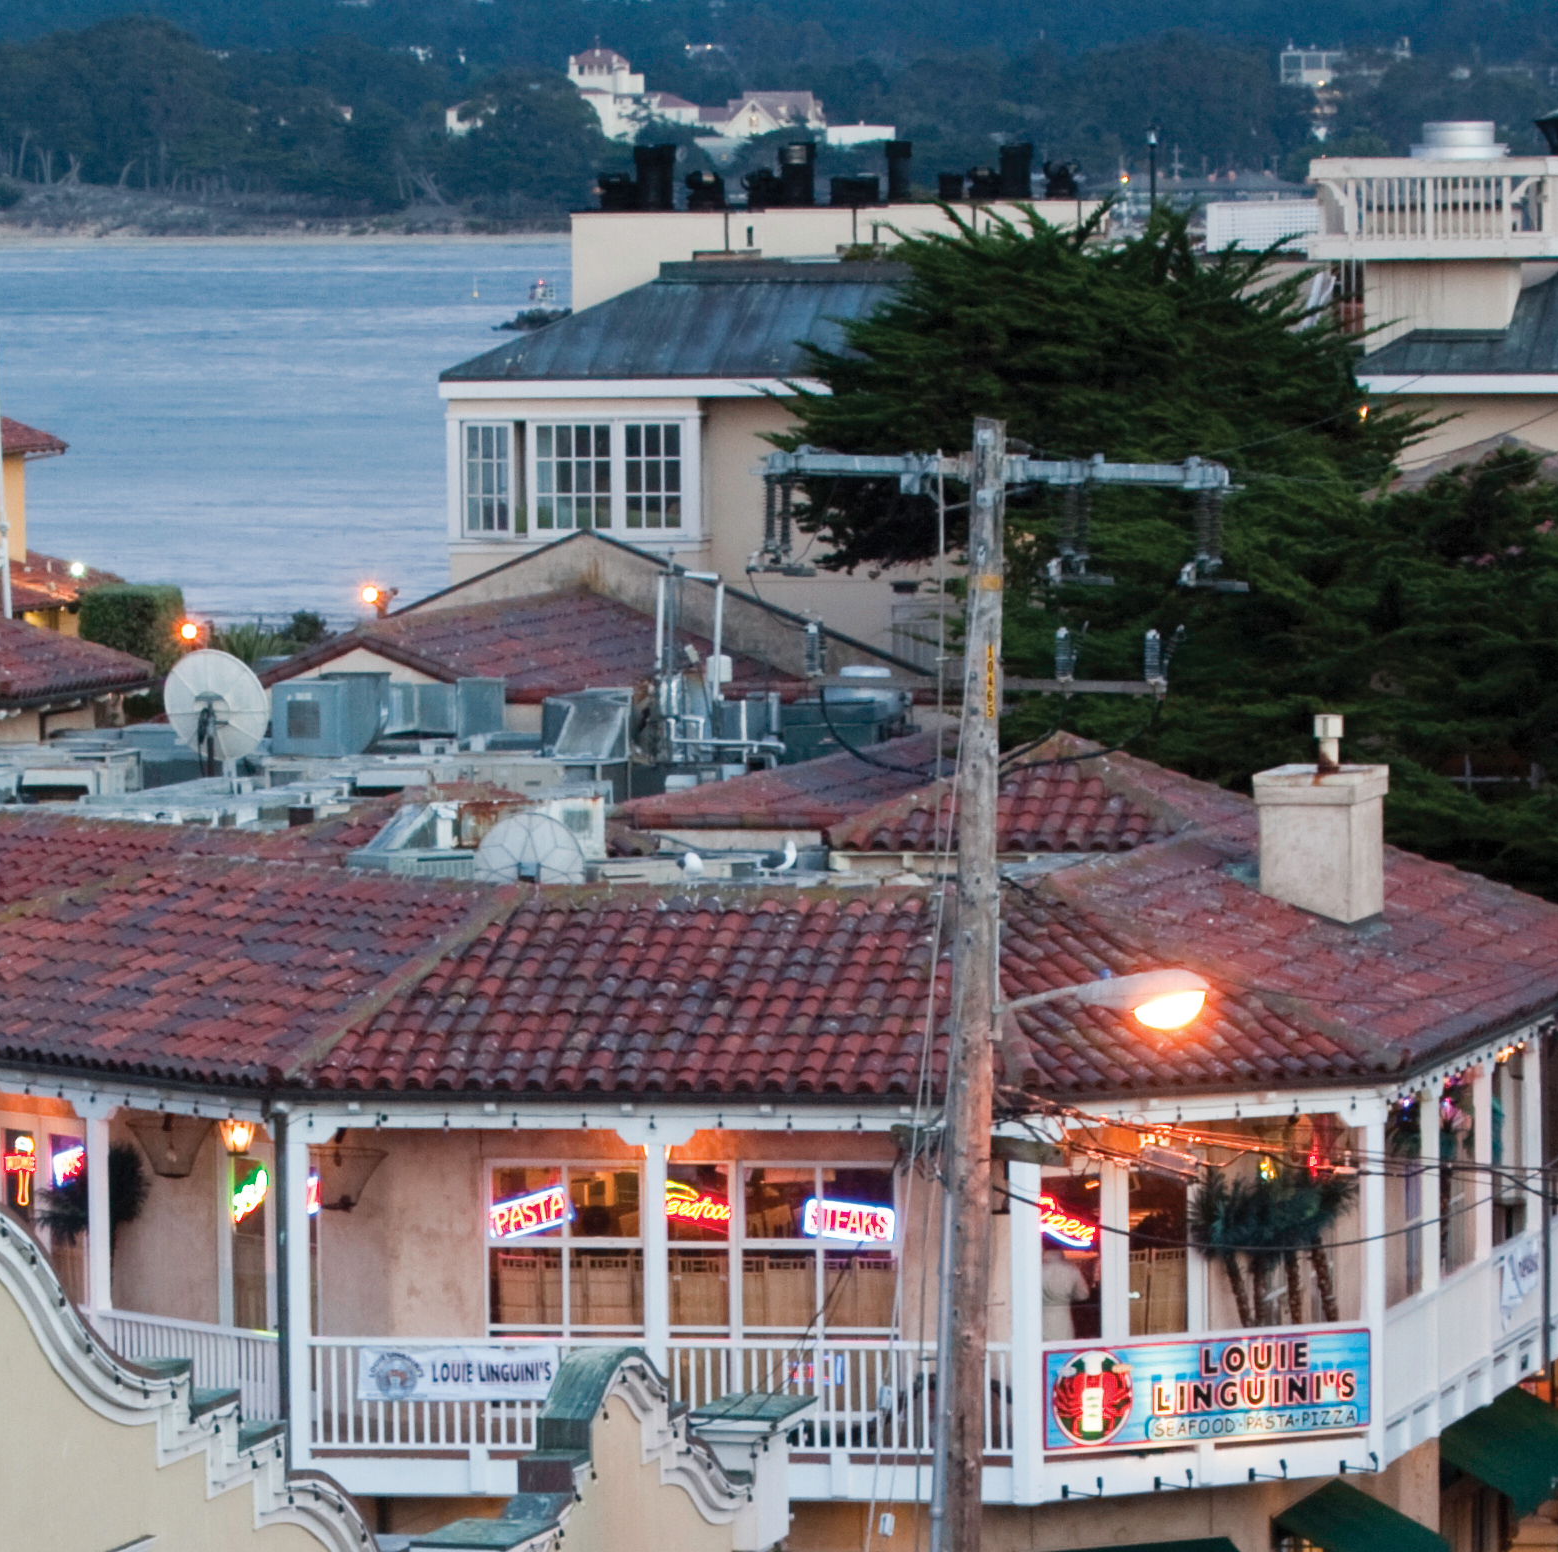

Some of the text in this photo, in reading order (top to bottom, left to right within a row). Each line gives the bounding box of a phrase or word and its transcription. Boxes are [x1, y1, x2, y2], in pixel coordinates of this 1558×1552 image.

[491, 1192, 565, 1236] PASTA
[810, 1207, 889, 1241] STEAKS
[432, 1361, 552, 1383] LOUIE LINGUINI'S
[1200, 1341, 1310, 1377] LOUIE
[1152, 1372, 1357, 1417] LINGUINI'S
